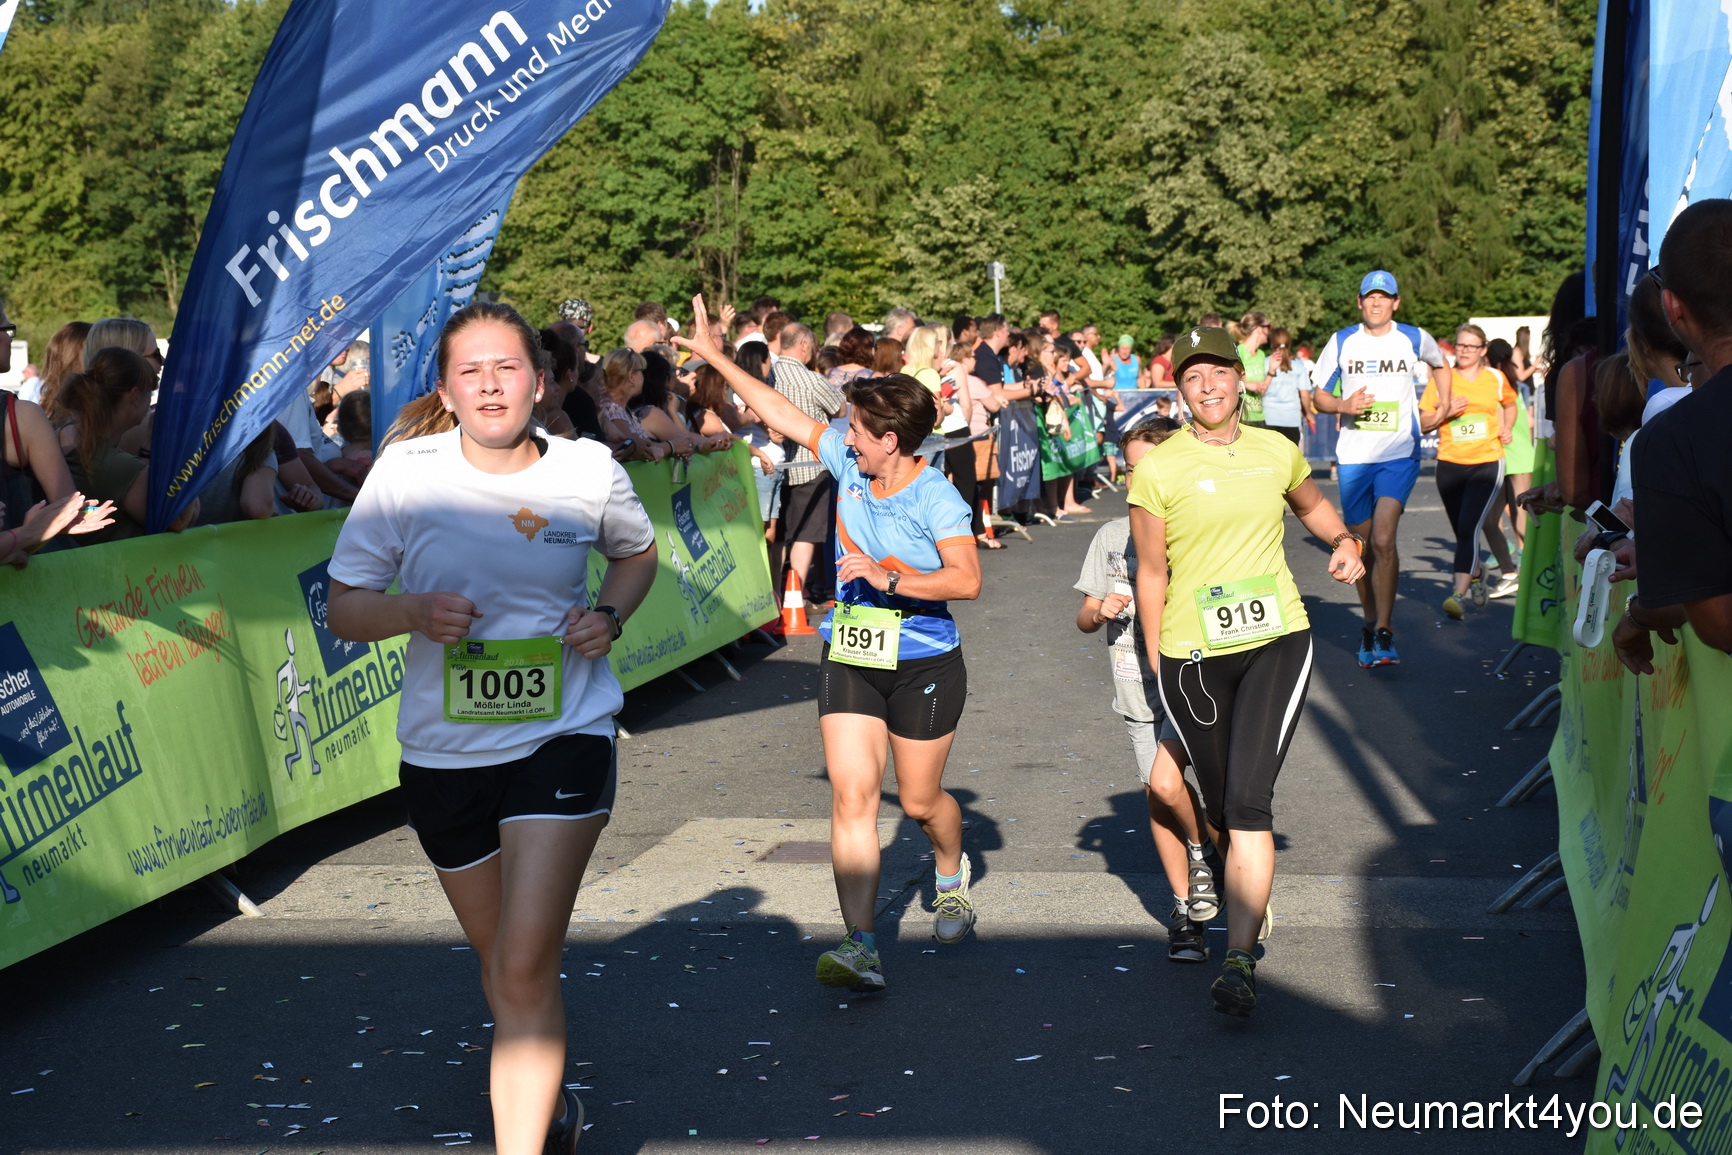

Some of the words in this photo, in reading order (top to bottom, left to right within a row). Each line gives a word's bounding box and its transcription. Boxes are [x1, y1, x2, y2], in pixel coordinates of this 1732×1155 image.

[424, 99, 501, 173] Druck
[498, 46, 549, 103] und
[225, 10, 528, 308] Frischmann
[166, 294, 346, 498] www.frischmann-net.de
[1460, 424, 1476, 435] 92
[521, 519, 536, 528] NM
[543, 530, 577, 539] LANDKREIS
[543, 537, 578, 545] NEUMARKT
[76, 573, 149, 649] Gesunde
[145, 563, 206, 611] Firmen
[1216, 599, 1265, 629] 919
[838, 624, 885, 651] 1591
[1221, 627, 1240, 636] Frank
[1240, 622, 1270, 633] Christine
[127, 630, 187, 689] laufen
[0, 669, 31, 700] scher
[459, 668, 546, 700] 1003
[0, 689, 37, 716] AUTOMOBILE
[474, 701, 505, 709] Mößler
[507, 701, 532, 709] Linda
[325, 716, 371, 764] neumarkt
[22, 822, 88, 887] neumarkt
